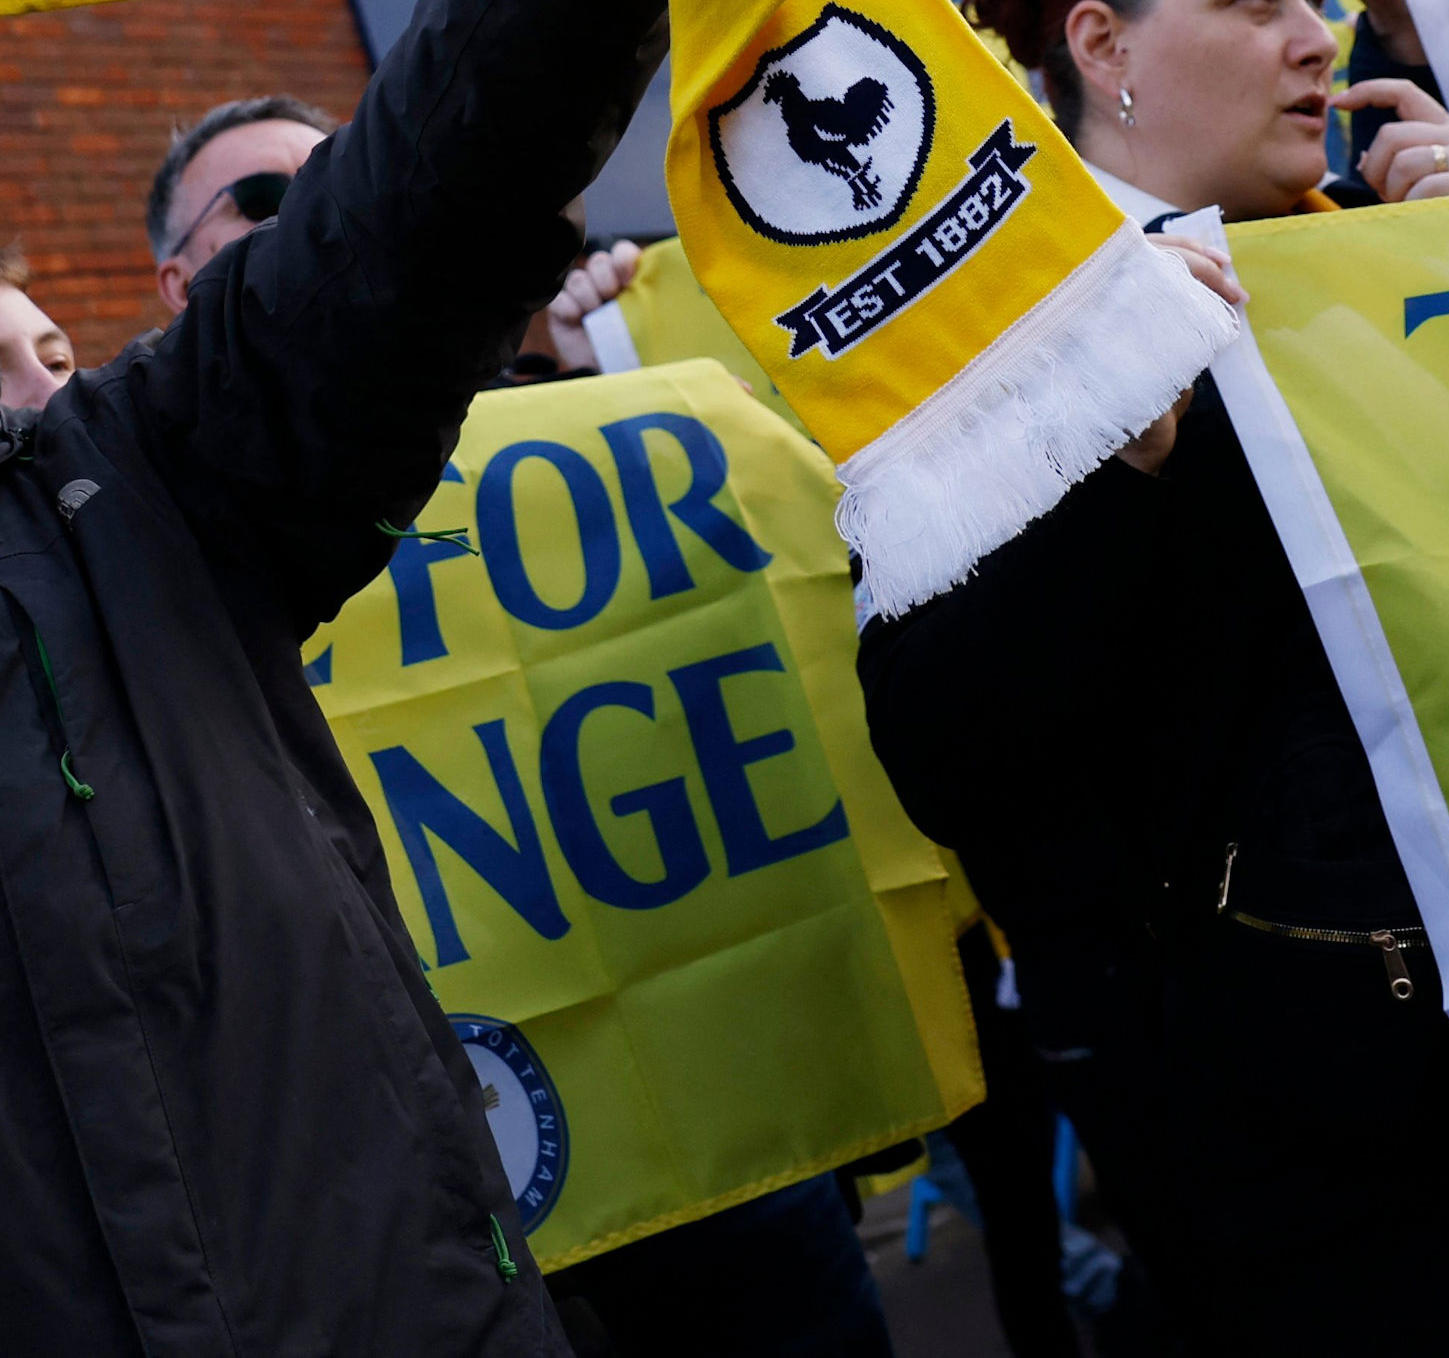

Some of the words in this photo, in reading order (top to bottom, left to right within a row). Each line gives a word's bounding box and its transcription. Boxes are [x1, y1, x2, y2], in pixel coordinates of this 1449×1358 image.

[831, 259, 908, 338] EST
[914, 173, 1013, 270] 1882
[368, 642, 852, 970] NGE
[468, 1023, 559, 1209] TOTTENHAM
